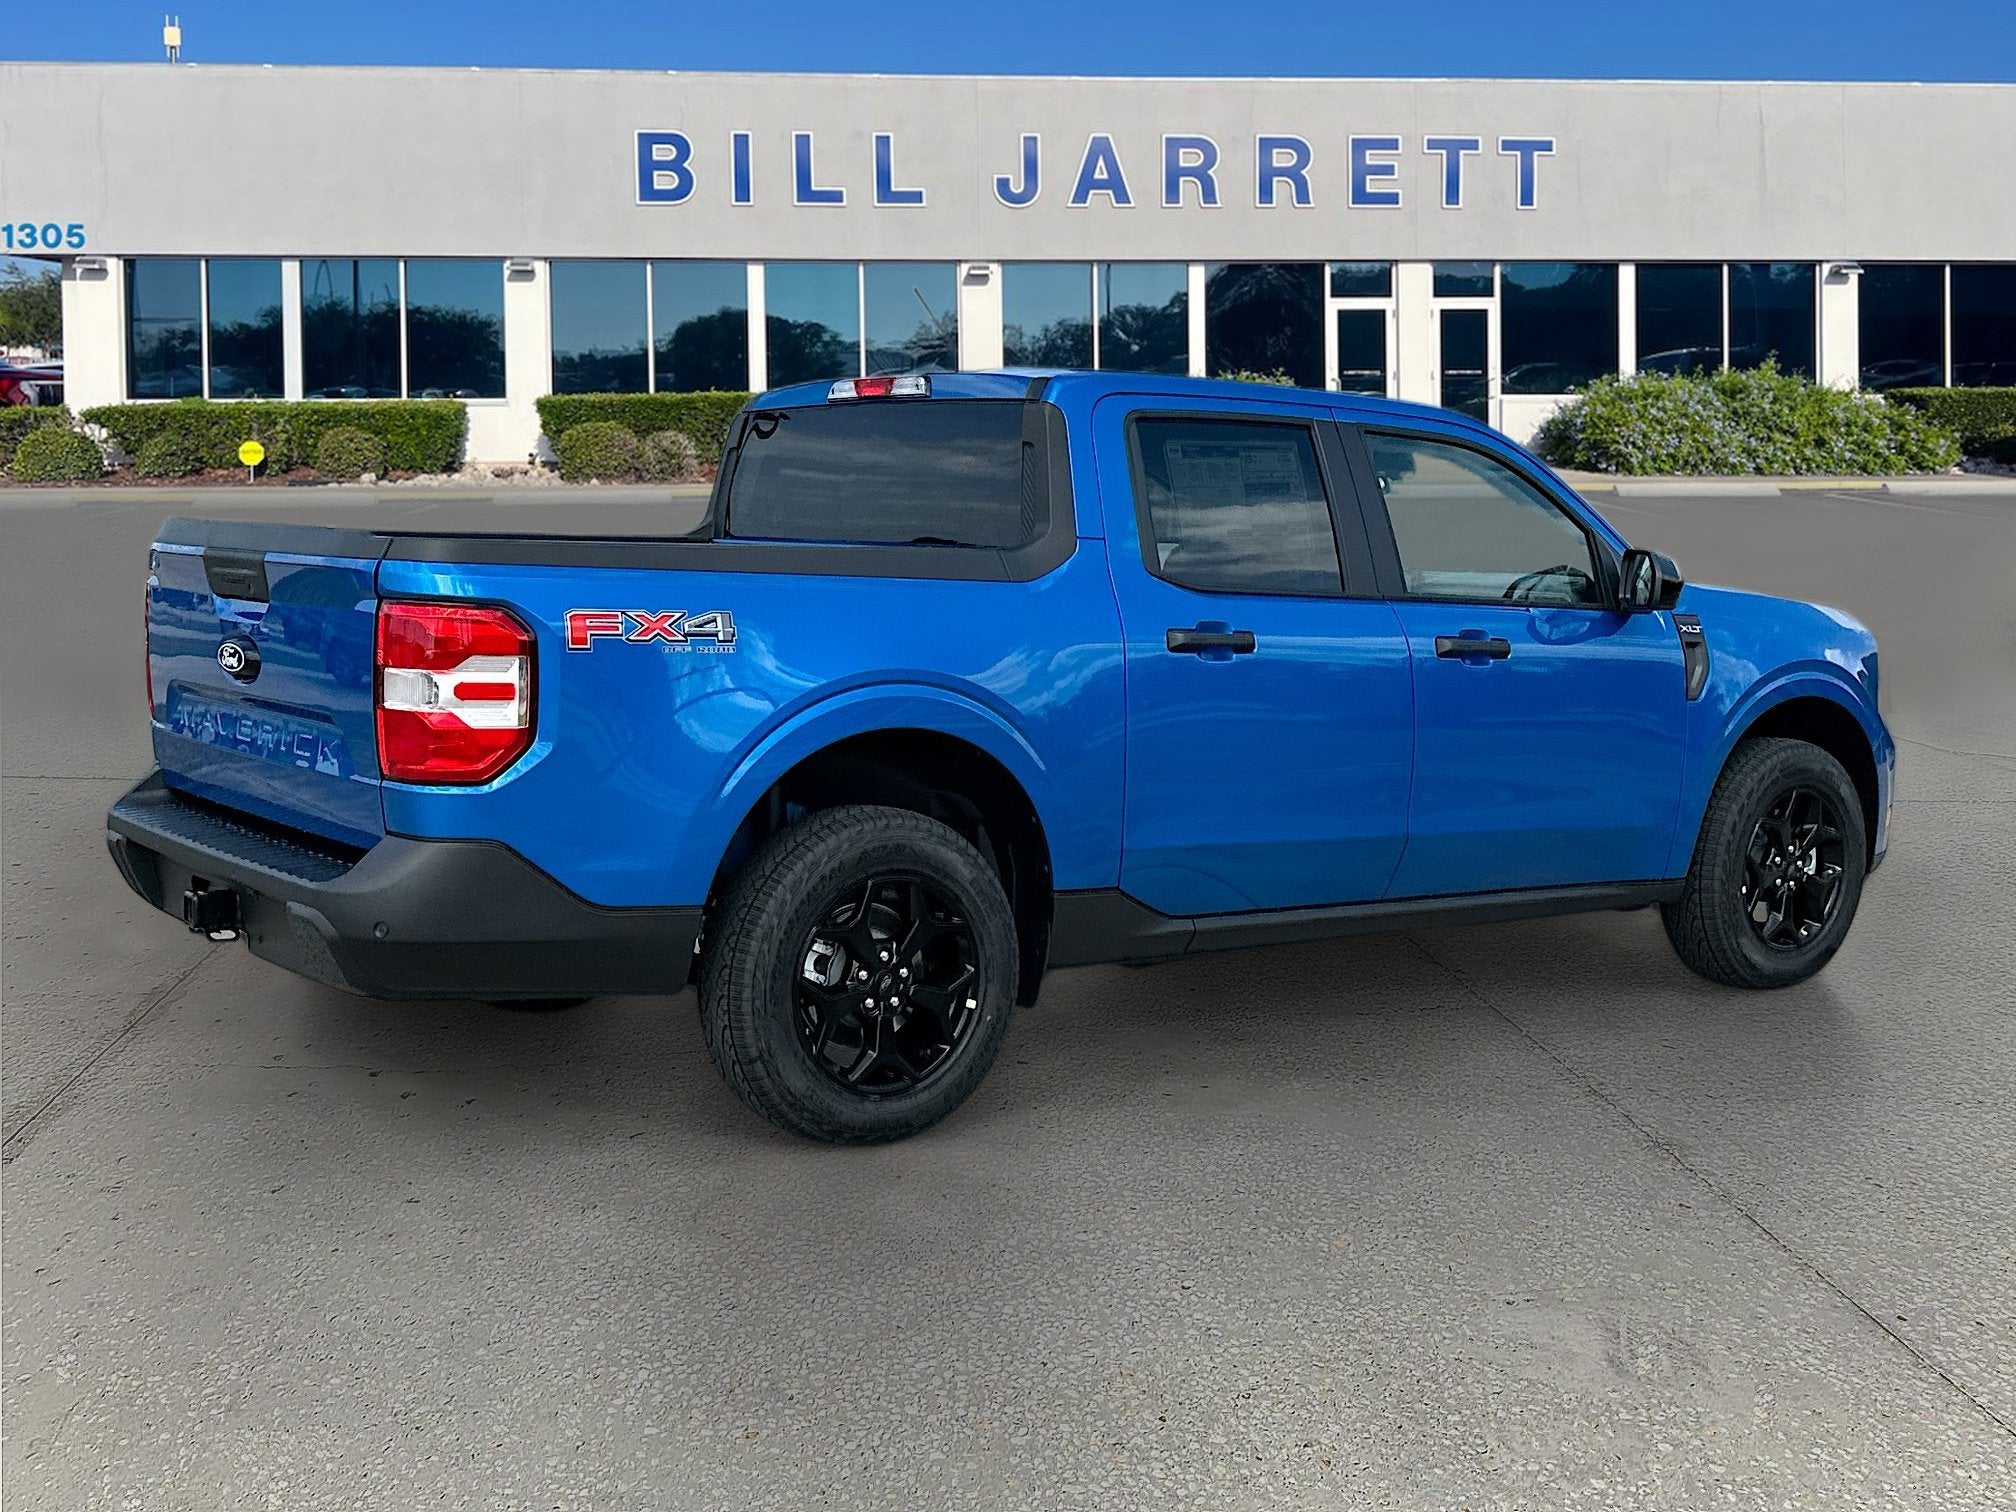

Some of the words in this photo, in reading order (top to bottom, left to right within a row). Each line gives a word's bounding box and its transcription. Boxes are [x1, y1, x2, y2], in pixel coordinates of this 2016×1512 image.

[634, 129, 926, 207] BILL
[993, 132, 1557, 210] JARRETT
[1, 223, 86, 248] 1305
[565, 609, 737, 652] FX4
[1679, 624, 1703, 633] XLT
[221, 646, 239, 667] Ford
[175, 704, 340, 768] MAVERICK
